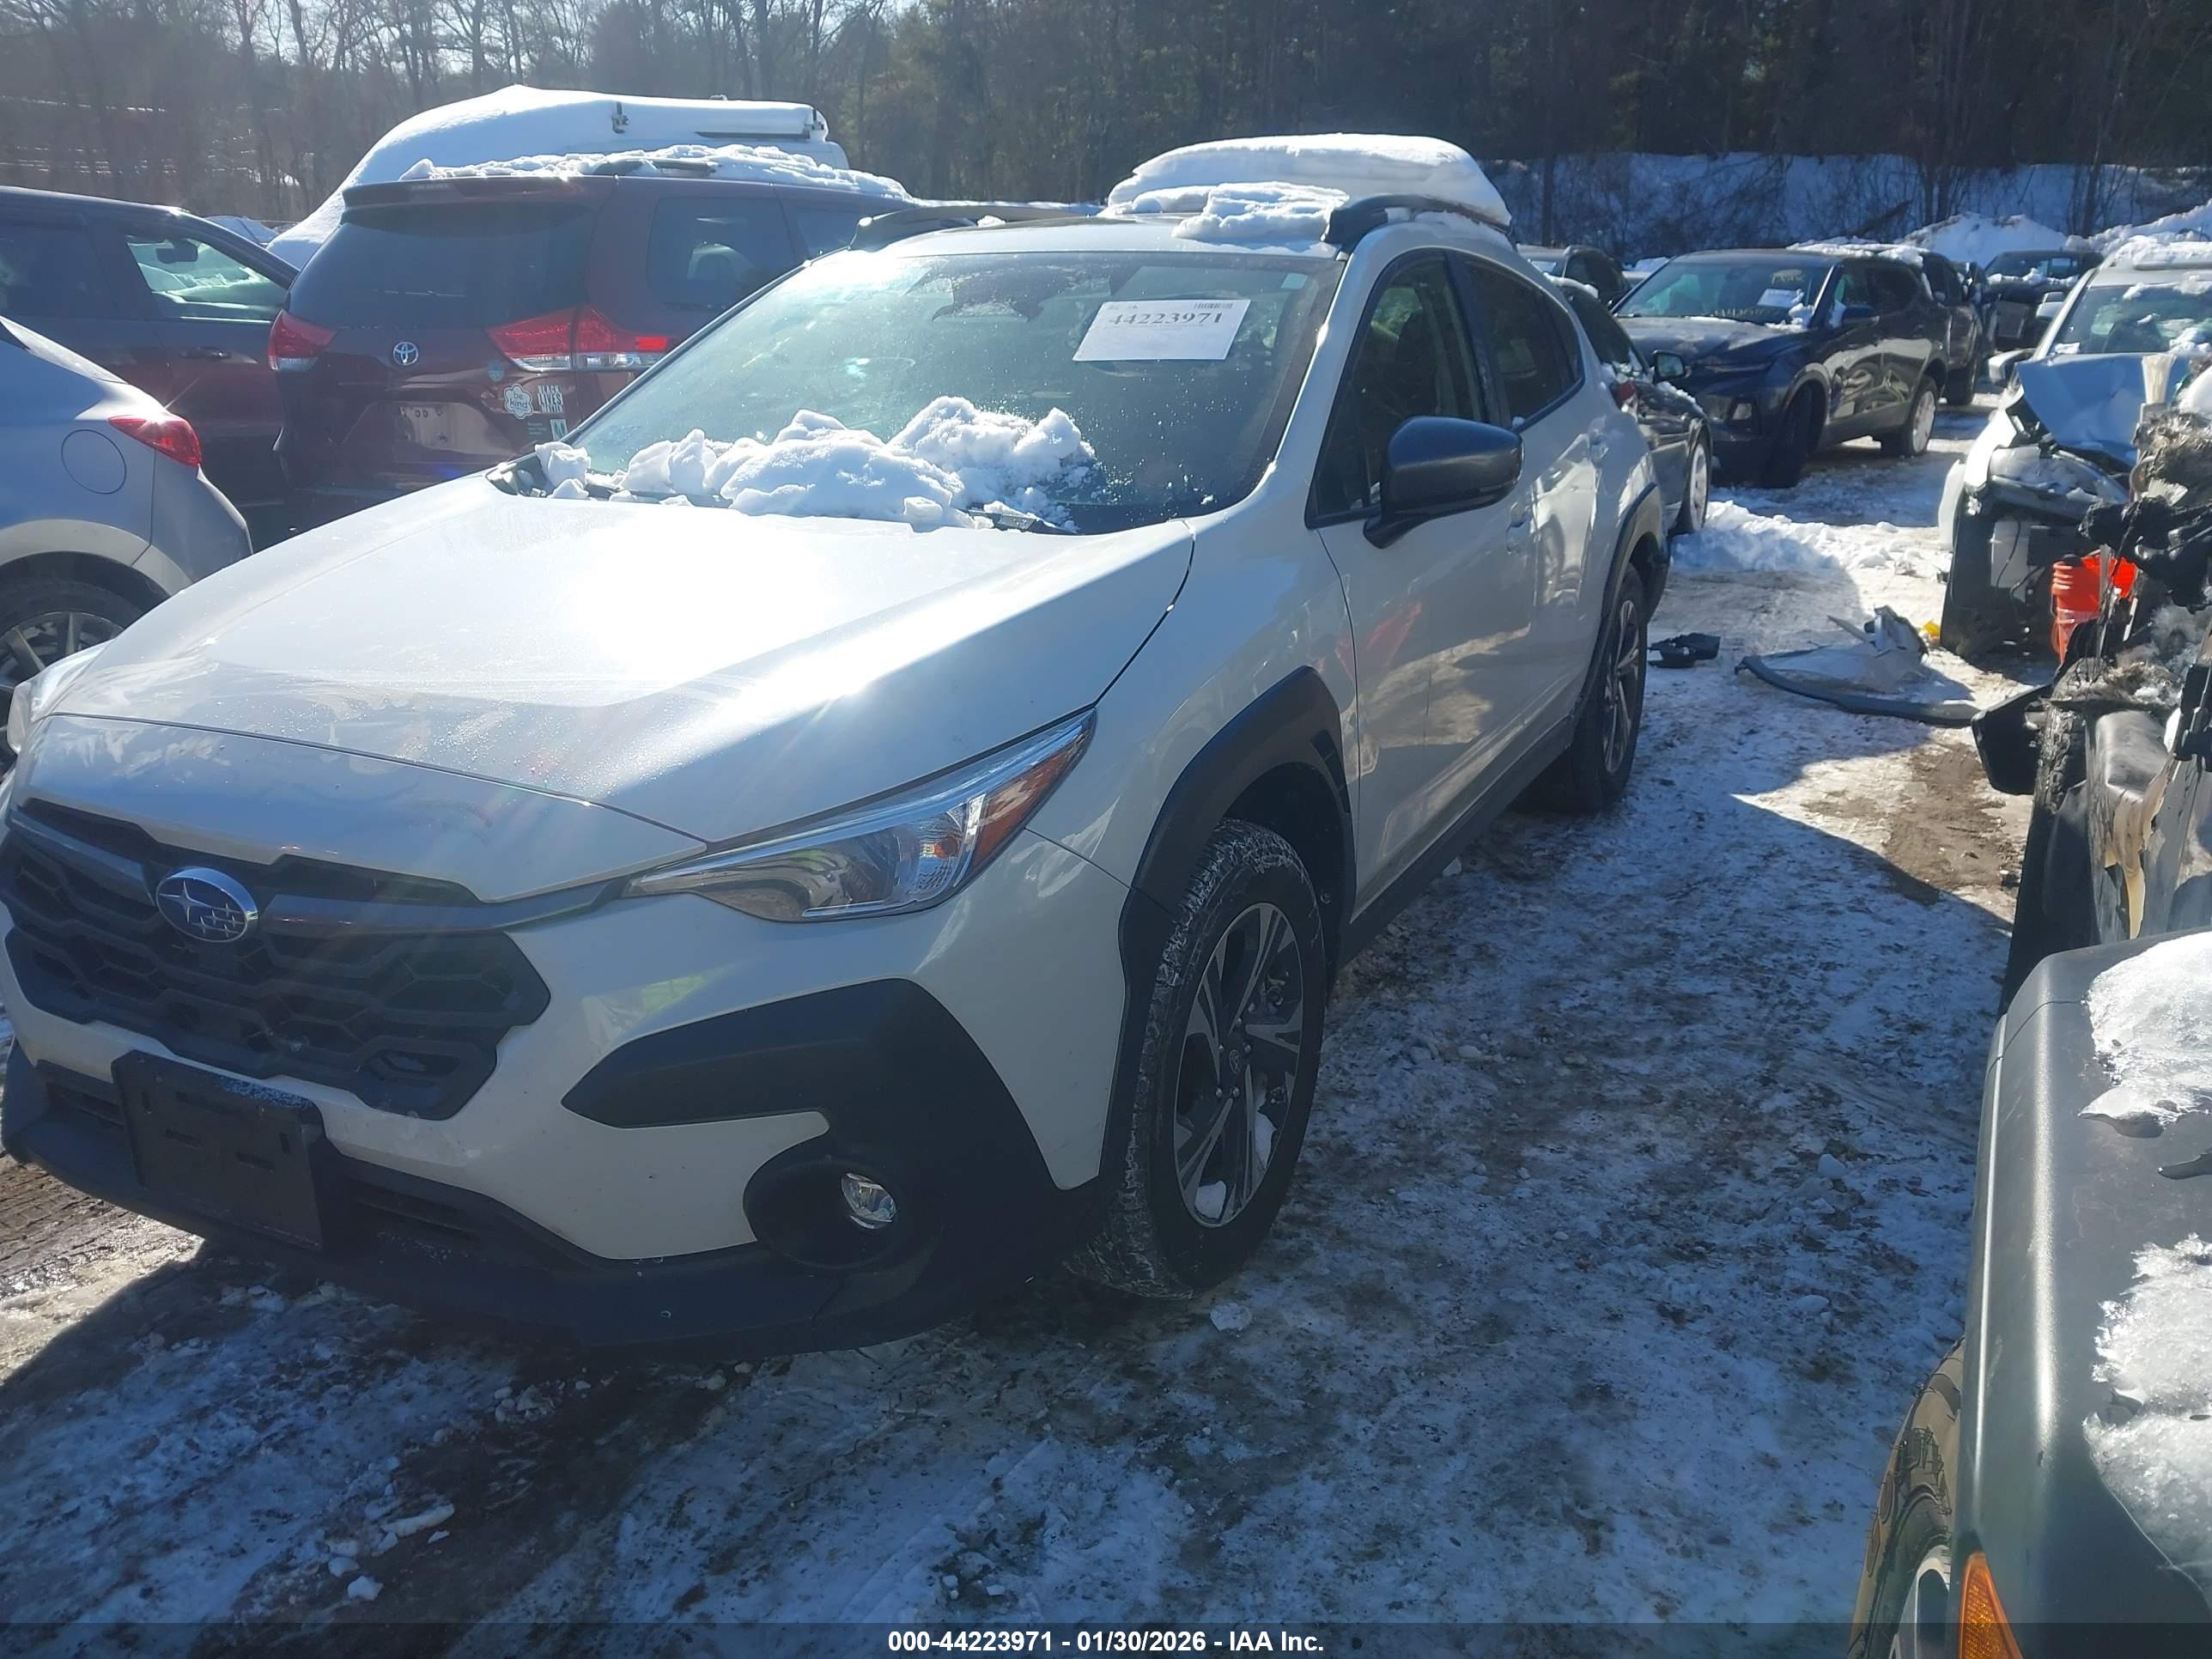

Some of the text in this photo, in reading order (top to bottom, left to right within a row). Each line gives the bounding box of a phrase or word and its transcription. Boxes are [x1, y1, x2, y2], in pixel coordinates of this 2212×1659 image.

[1109, 312, 1223, 325] 44223971
[538, 385, 560, 393] BLACK
[514, 392, 524, 400] be
[538, 392, 564, 405] LIVES
[510, 398, 527, 408] kind
